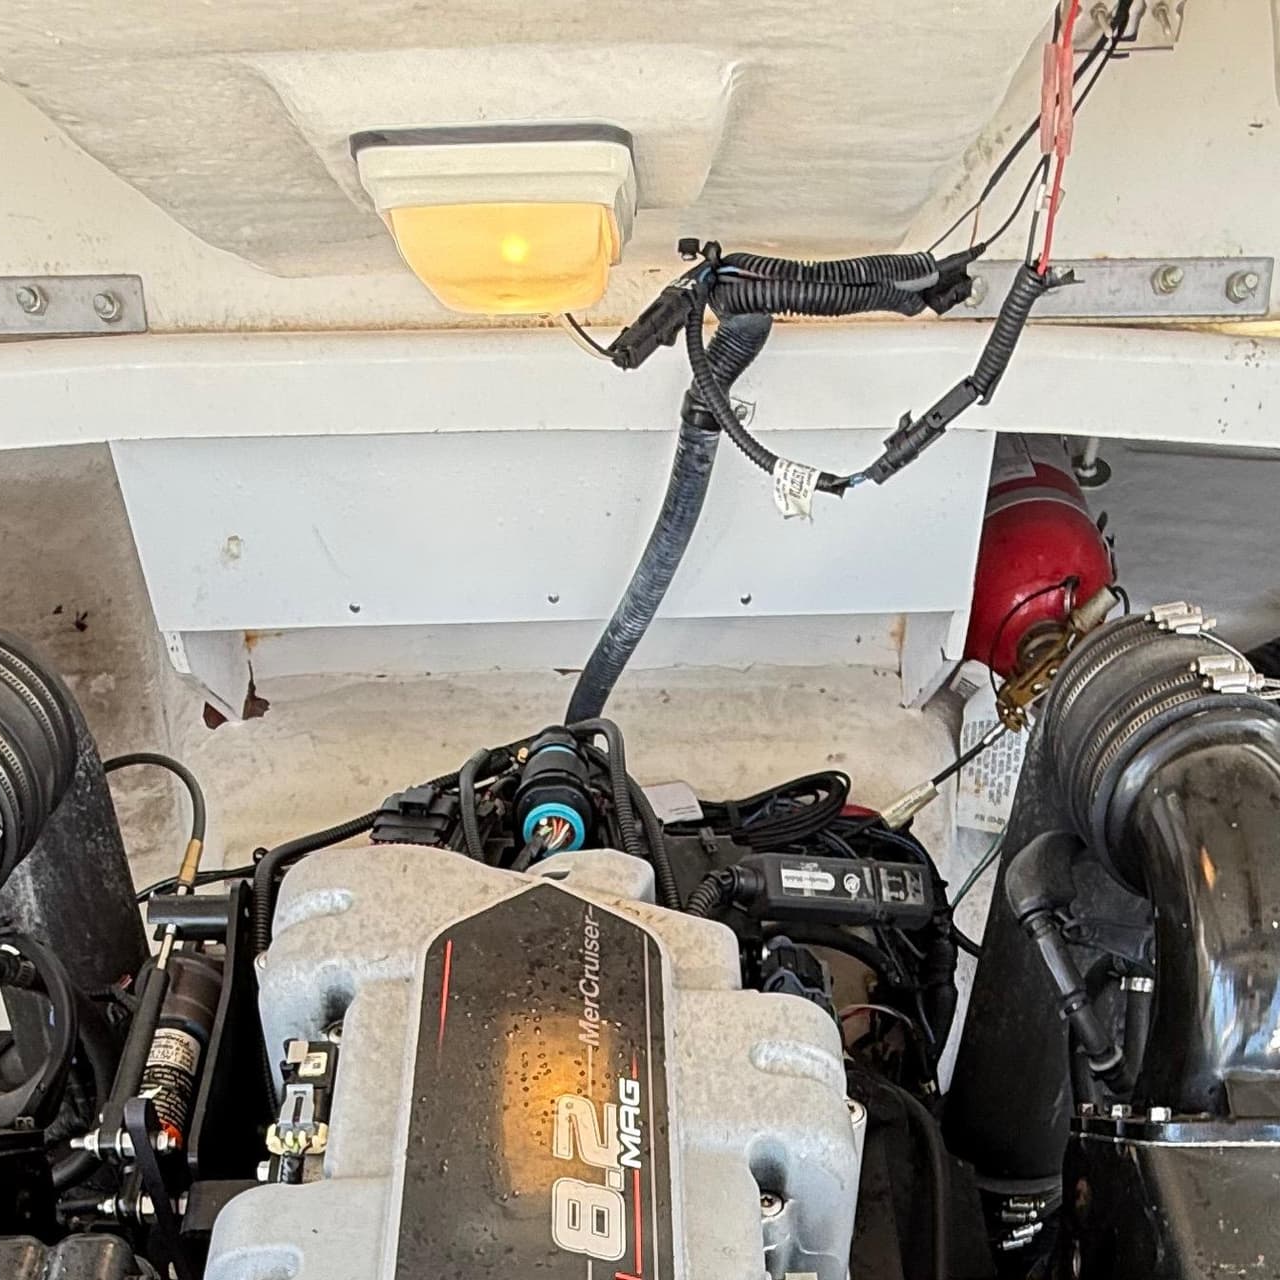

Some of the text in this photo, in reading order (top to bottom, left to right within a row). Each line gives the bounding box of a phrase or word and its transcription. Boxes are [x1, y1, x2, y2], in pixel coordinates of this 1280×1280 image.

[579, 915, 601, 1048] MerCruiser
[552, 1094, 626, 1261] 8.2
[619, 1077, 642, 1169] MAG
